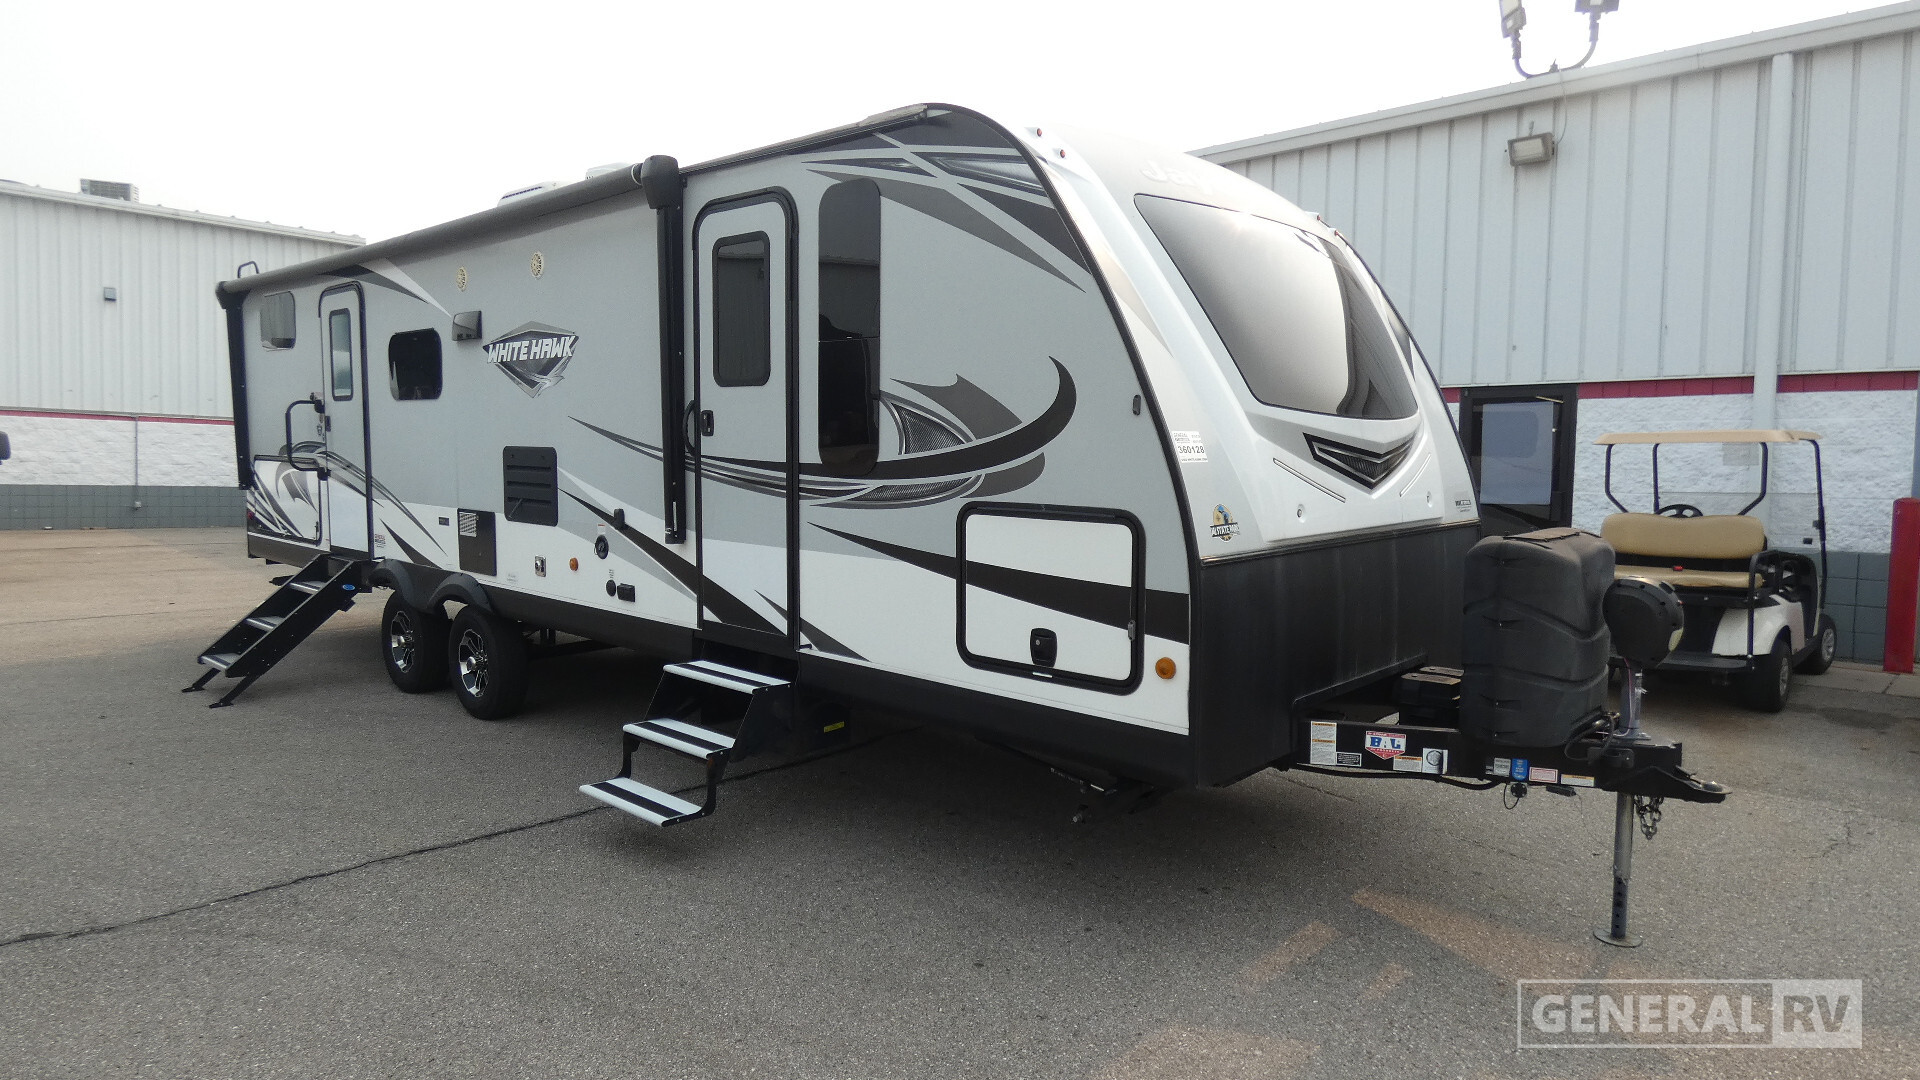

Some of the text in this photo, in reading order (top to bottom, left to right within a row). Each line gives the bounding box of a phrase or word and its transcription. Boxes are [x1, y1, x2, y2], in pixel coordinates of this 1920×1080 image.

[488, 335, 576, 363] WHITE HAWK
[1178, 445, 1205, 454] 360128
[1370, 736, 1402, 749] BAL
